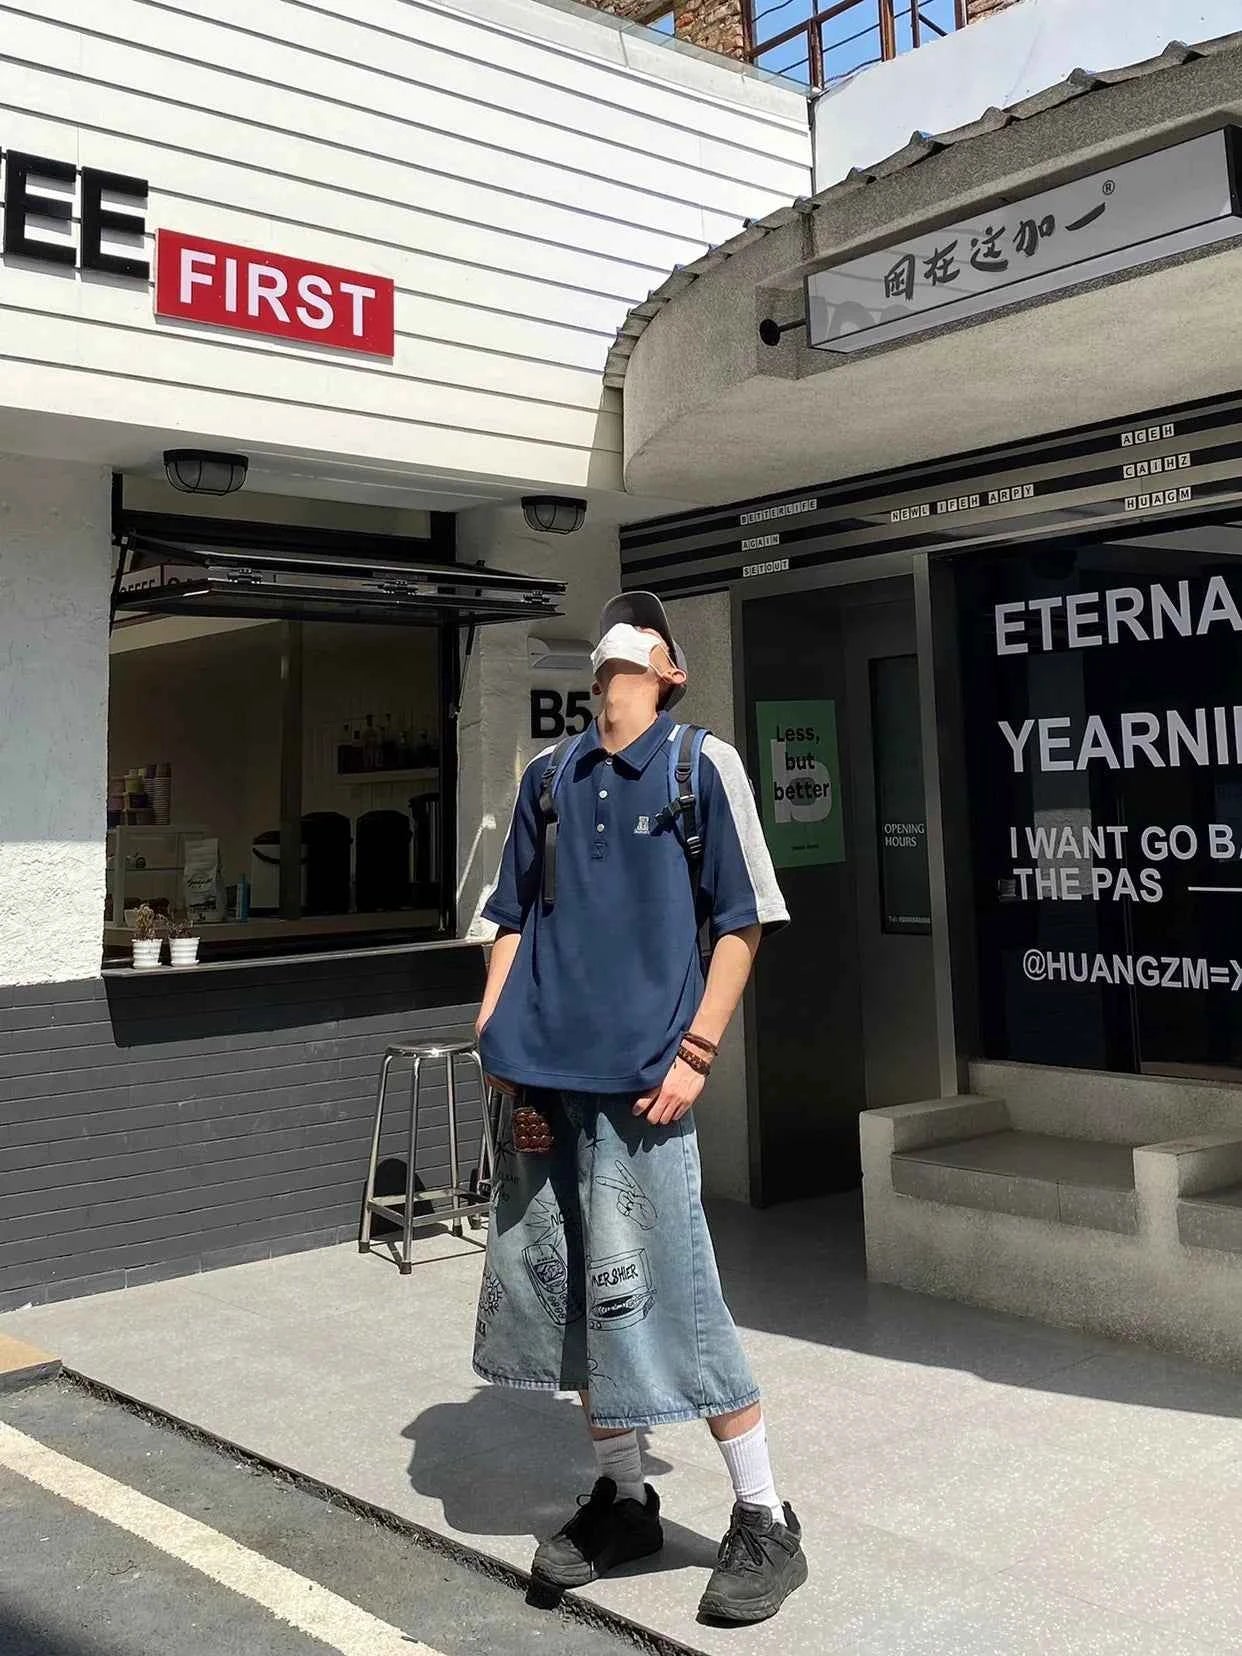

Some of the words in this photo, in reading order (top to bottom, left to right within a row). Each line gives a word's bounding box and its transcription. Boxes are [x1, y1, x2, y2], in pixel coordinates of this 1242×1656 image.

[0, 146, 150, 282] EE
[180, 248, 375, 337] FIRST
[1121, 423, 1174, 447] ACEH
[1123, 453, 1191, 479] CAIHZ
[891, 504, 930, 522] NEWL
[988, 484, 1034, 505] ARPY
[1125, 487, 1191, 511] HUAGM
[740, 499, 817, 525] BETTERLIFE
[742, 534, 780, 551] AGAIN
[743, 559, 789, 577] SETOUT
[994, 575, 1242, 656] ETERNA
[530, 689, 594, 739] B5
[776, 725, 821, 744] Less,
[784, 751, 816, 771] but
[774, 781, 831, 801] better
[884, 823, 926, 834] OPENING
[885, 836, 918, 847] HOURS
[1010, 826, 1019, 859] I
[1024, 825, 1129, 860] WANT
[1140, 824, 1199, 861] GO
[1208, 823, 1242, 860] B
[1012, 867, 1083, 901] THE
[1091, 867, 1165, 903] PAS
